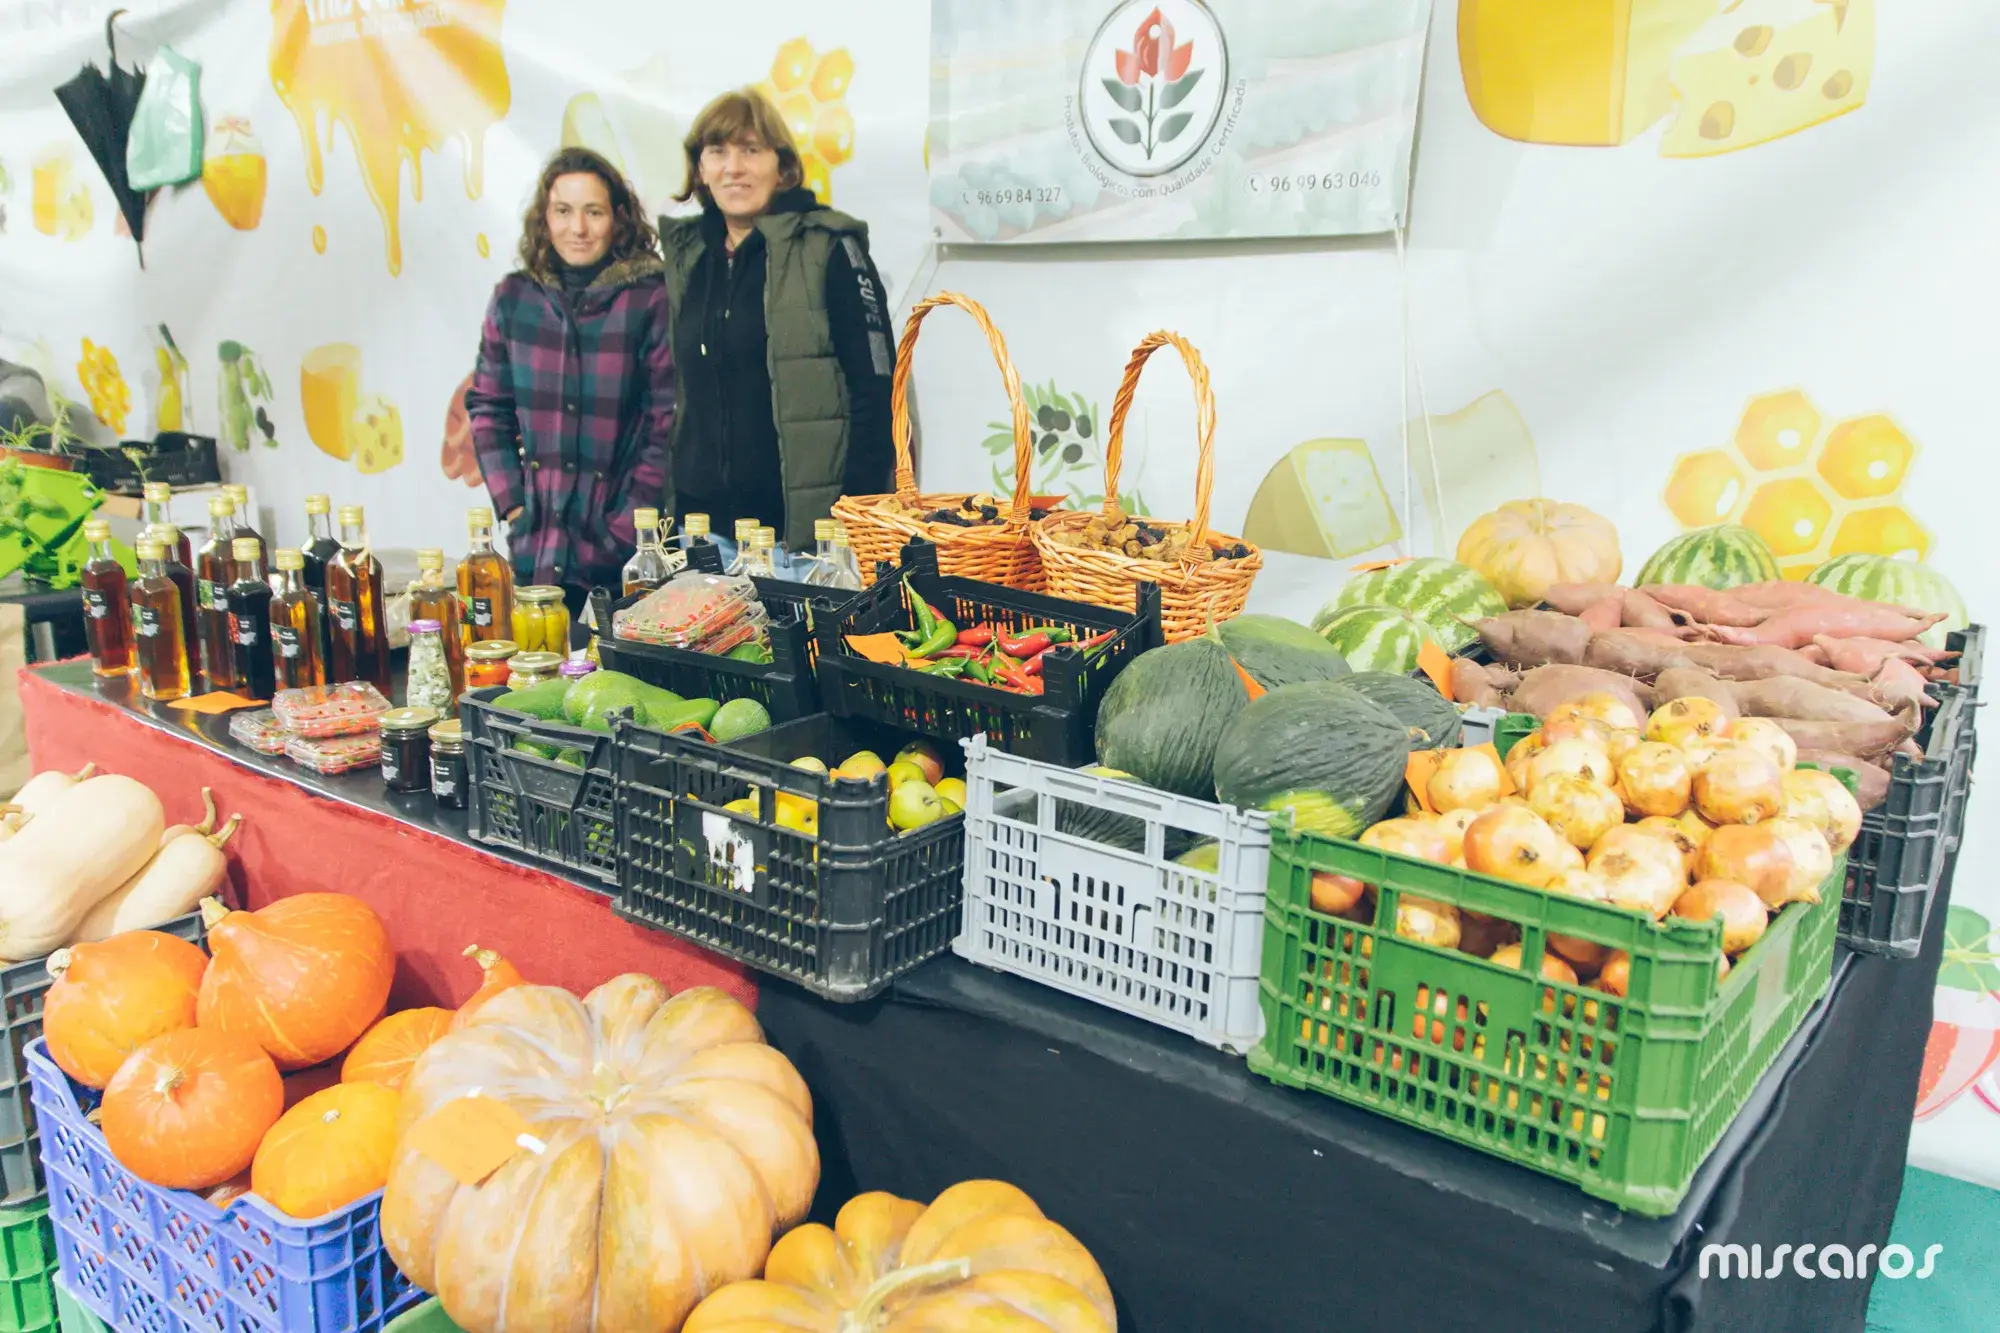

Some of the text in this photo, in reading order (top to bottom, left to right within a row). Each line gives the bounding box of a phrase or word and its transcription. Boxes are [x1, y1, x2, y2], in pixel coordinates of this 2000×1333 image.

[1063, 94, 1082, 156] Produtos
[1131, 187, 1158, 199] com
[1158, 156, 1213, 196] Qualidade
[1211, 76, 1247, 156] Certificada
[1270, 175, 1291, 193] 96
[1295, 173, 1317, 192] 99
[1321, 172, 1344, 190] 63
[976, 186, 1062, 205] 96 69 84 327
